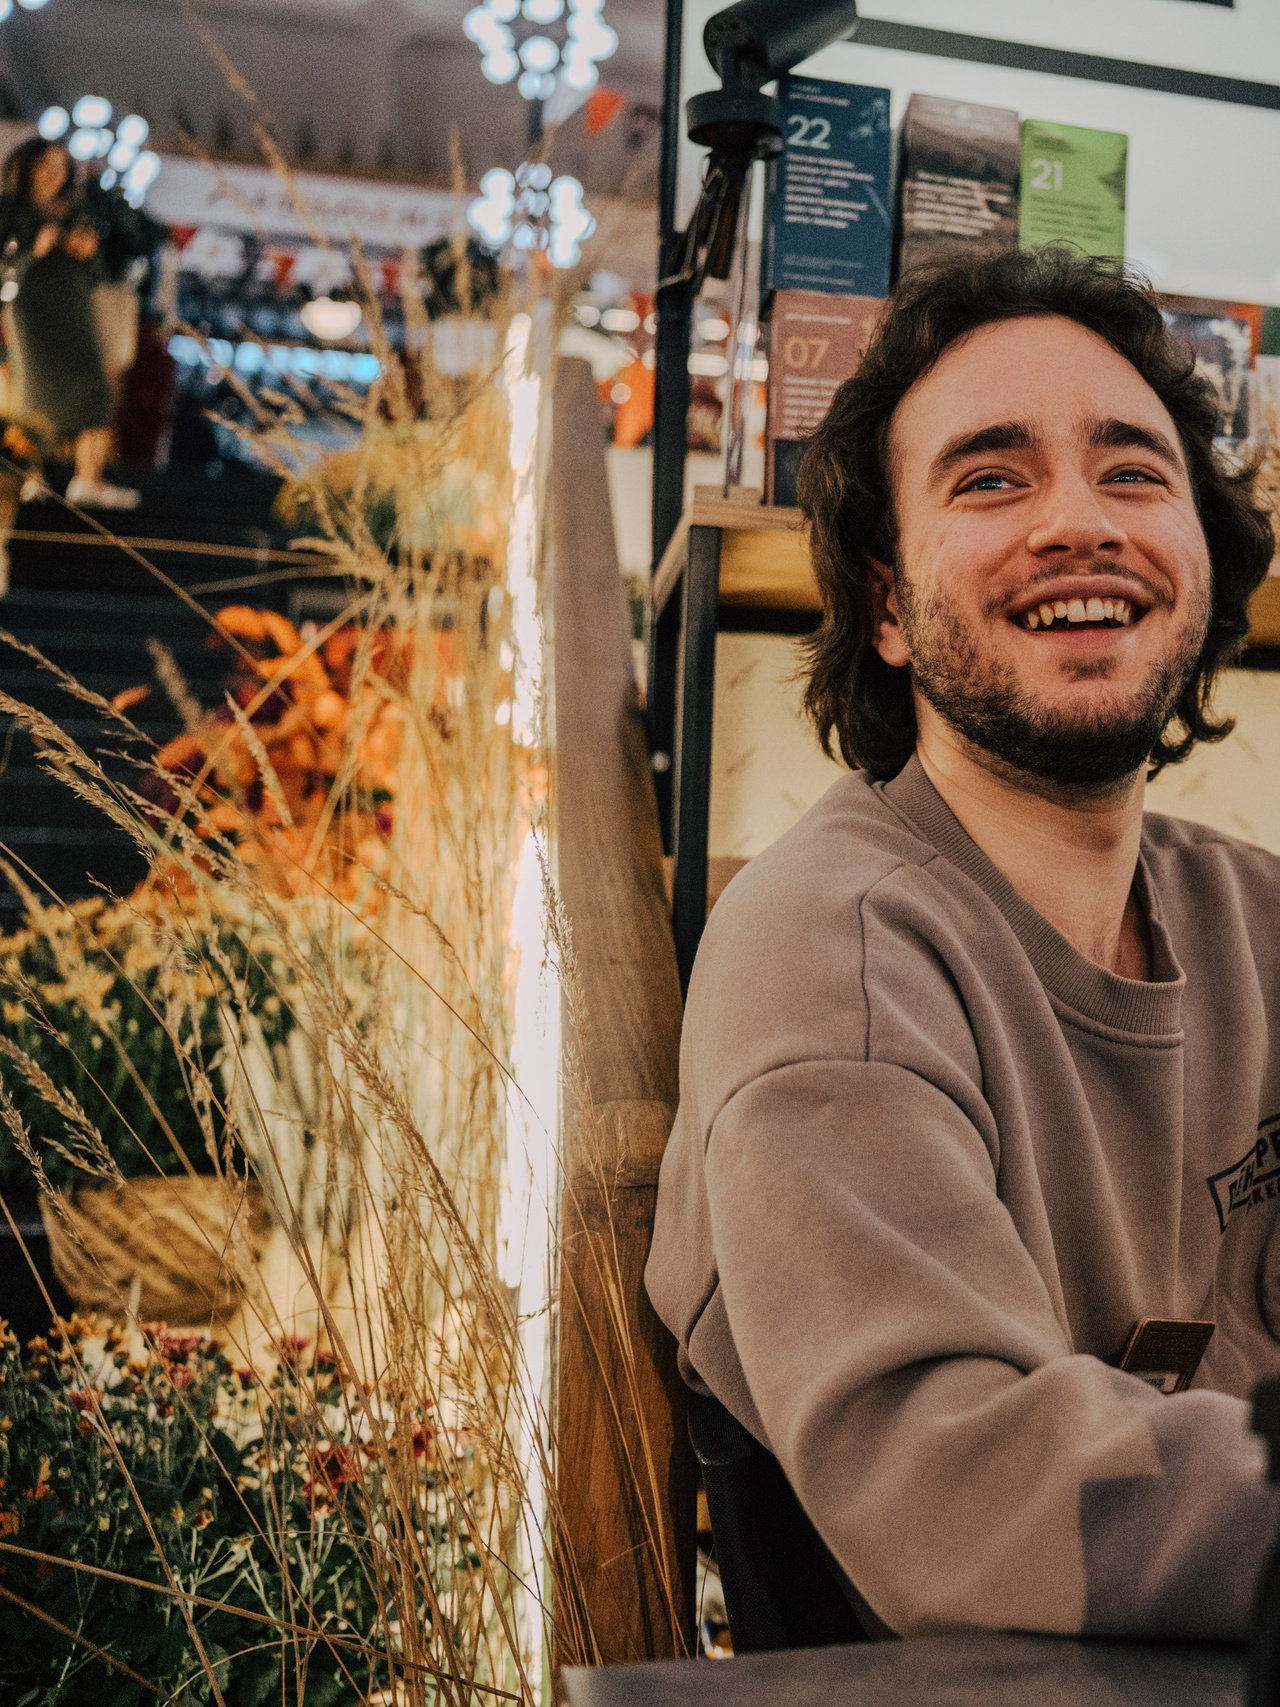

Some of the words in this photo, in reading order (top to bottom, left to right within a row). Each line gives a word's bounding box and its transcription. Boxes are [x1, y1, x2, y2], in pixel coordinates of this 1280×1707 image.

[787, 114, 831, 150] 22
[1030, 157, 1063, 191] 21
[784, 336, 829, 369] 07
